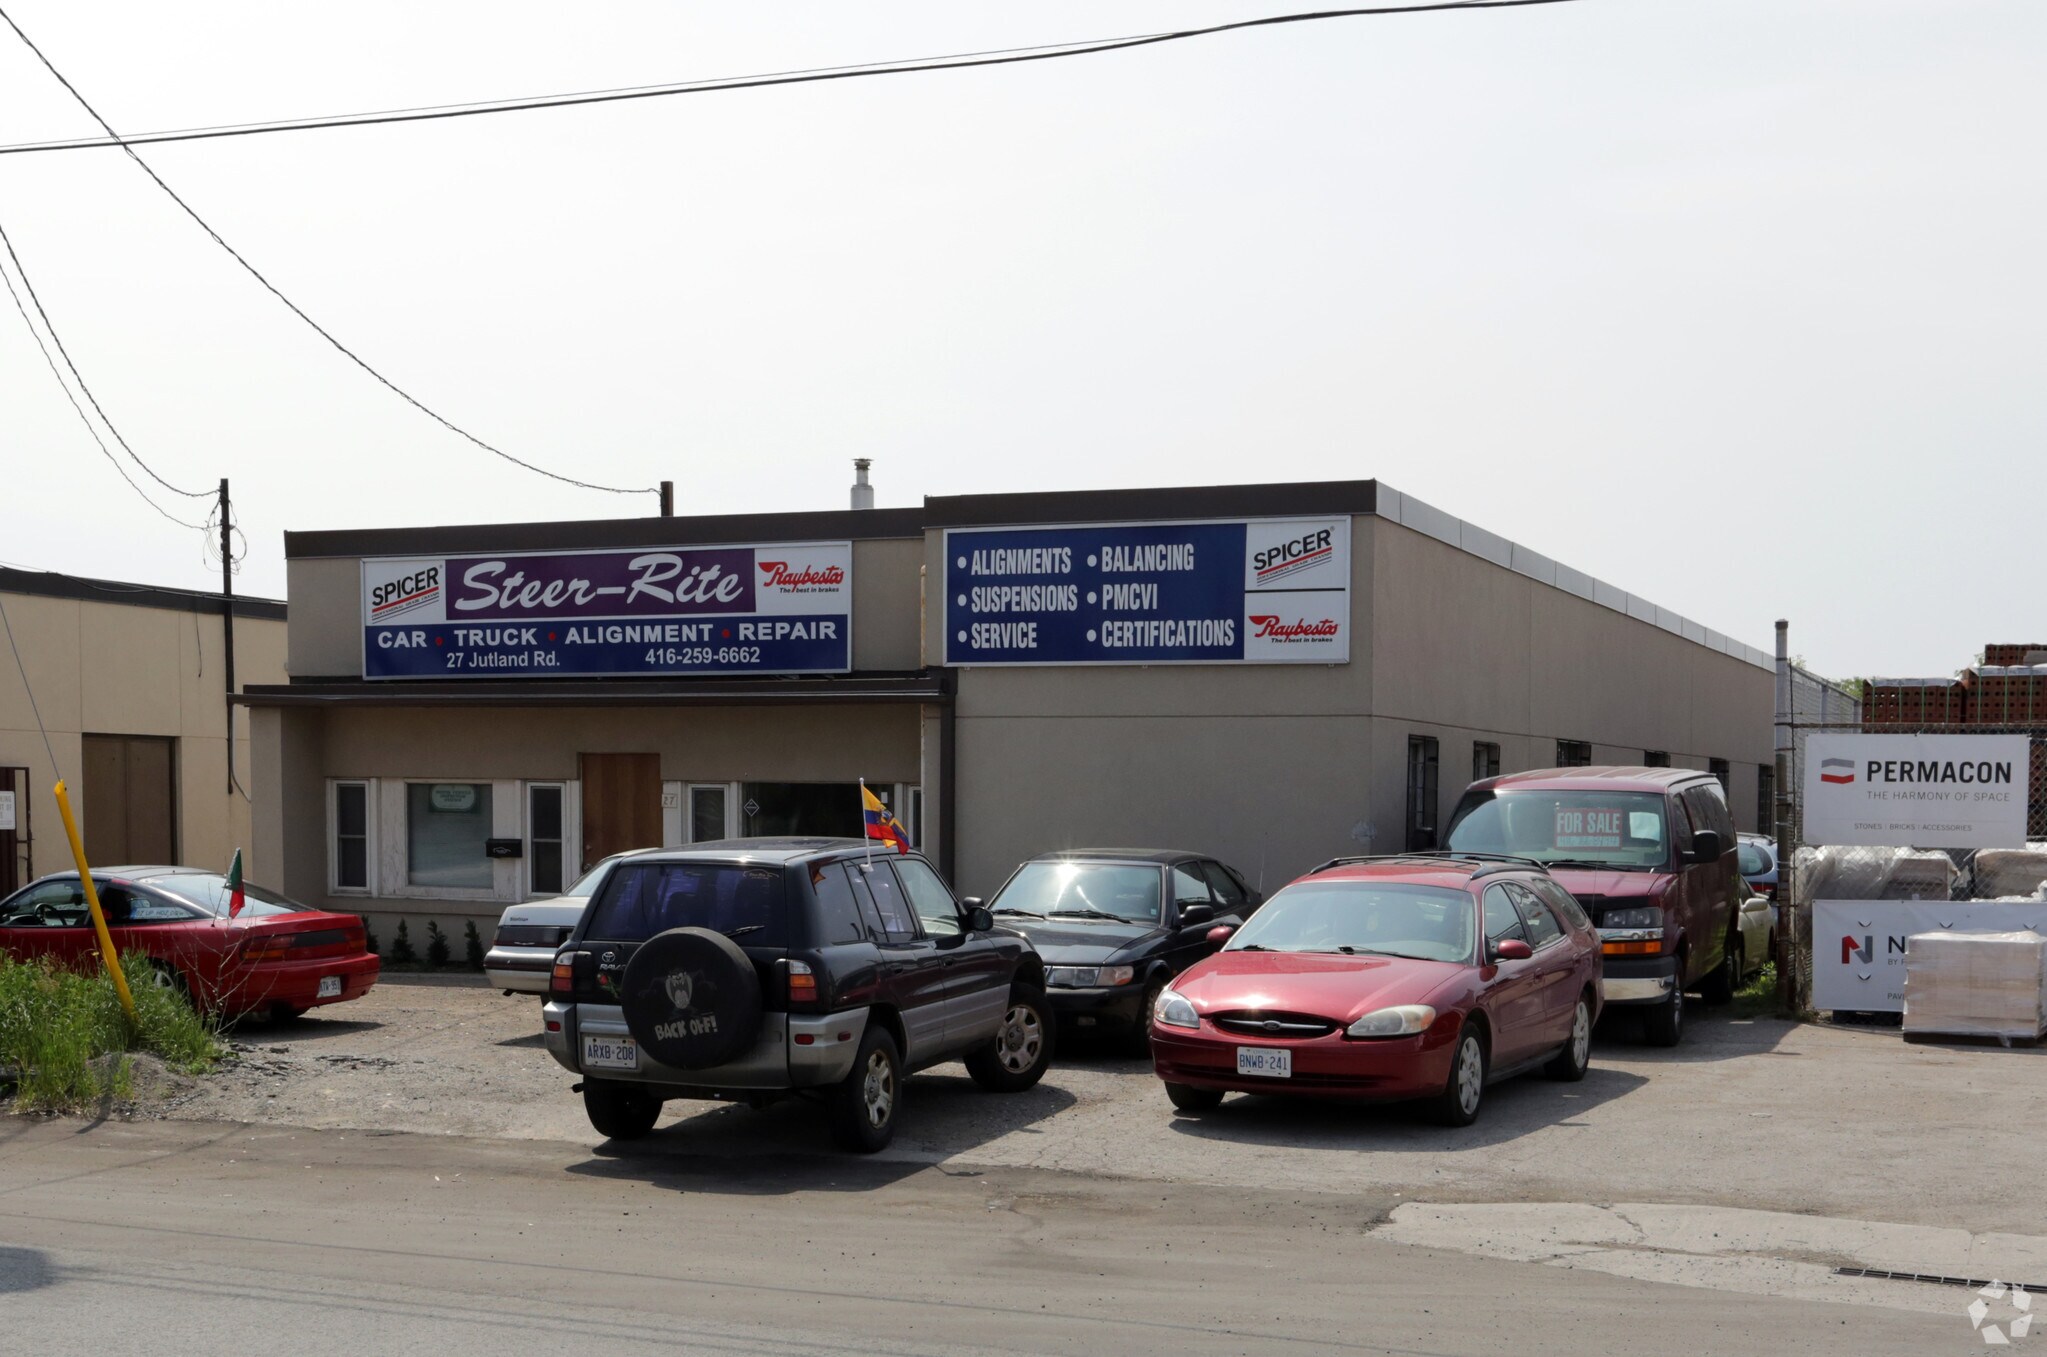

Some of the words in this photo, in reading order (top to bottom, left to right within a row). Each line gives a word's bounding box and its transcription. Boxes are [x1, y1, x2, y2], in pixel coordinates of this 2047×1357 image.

[971, 547, 1072, 575] ALIGNMENTS
[1101, 543, 1194, 572] BALANCING
[1253, 529, 1331, 571] SPICER
[372, 567, 439, 606] SPICER
[454, 553, 743, 610] Steer-Rite
[758, 561, 844, 592] Raybestos
[971, 584, 1078, 613] SUSPENSIONS
[1102, 583, 1158, 610] PMCVI
[377, 630, 427, 648] CAR
[454, 628, 537, 647] TRUCK
[565, 624, 713, 644] ALIGNMENT
[738, 622, 837, 641] REPAIR
[971, 622, 1037, 649] SERVICE
[1101, 619, 1235, 648] CERTIFICATIONS
[1249, 615, 1338, 643] Raybestos
[446, 652, 464, 668] 27
[469, 651, 529, 668] Jutland
[534, 650, 560, 667] Rd.
[645, 647, 760, 665] 416-259-6662
[1866, 760, 2012, 784] PERMACON
[663, 796, 676, 806] 27
[1866, 791, 1888, 800] THE
[1893, 791, 1950, 801] HARMONY
[1954, 792, 1970, 801] OF
[1973, 792, 2011, 802] SPACE
[1557, 812, 1582, 833] FOR
[1587, 812, 1620, 834] SALE
[1854, 822, 1882, 830] STONES
[1889, 823, 1916, 831] BRICKS
[1922, 823, 1972, 832] ACCESSORIES
[654, 1020, 687, 1040] BACK
[690, 1015, 718, 1036] OFF!
